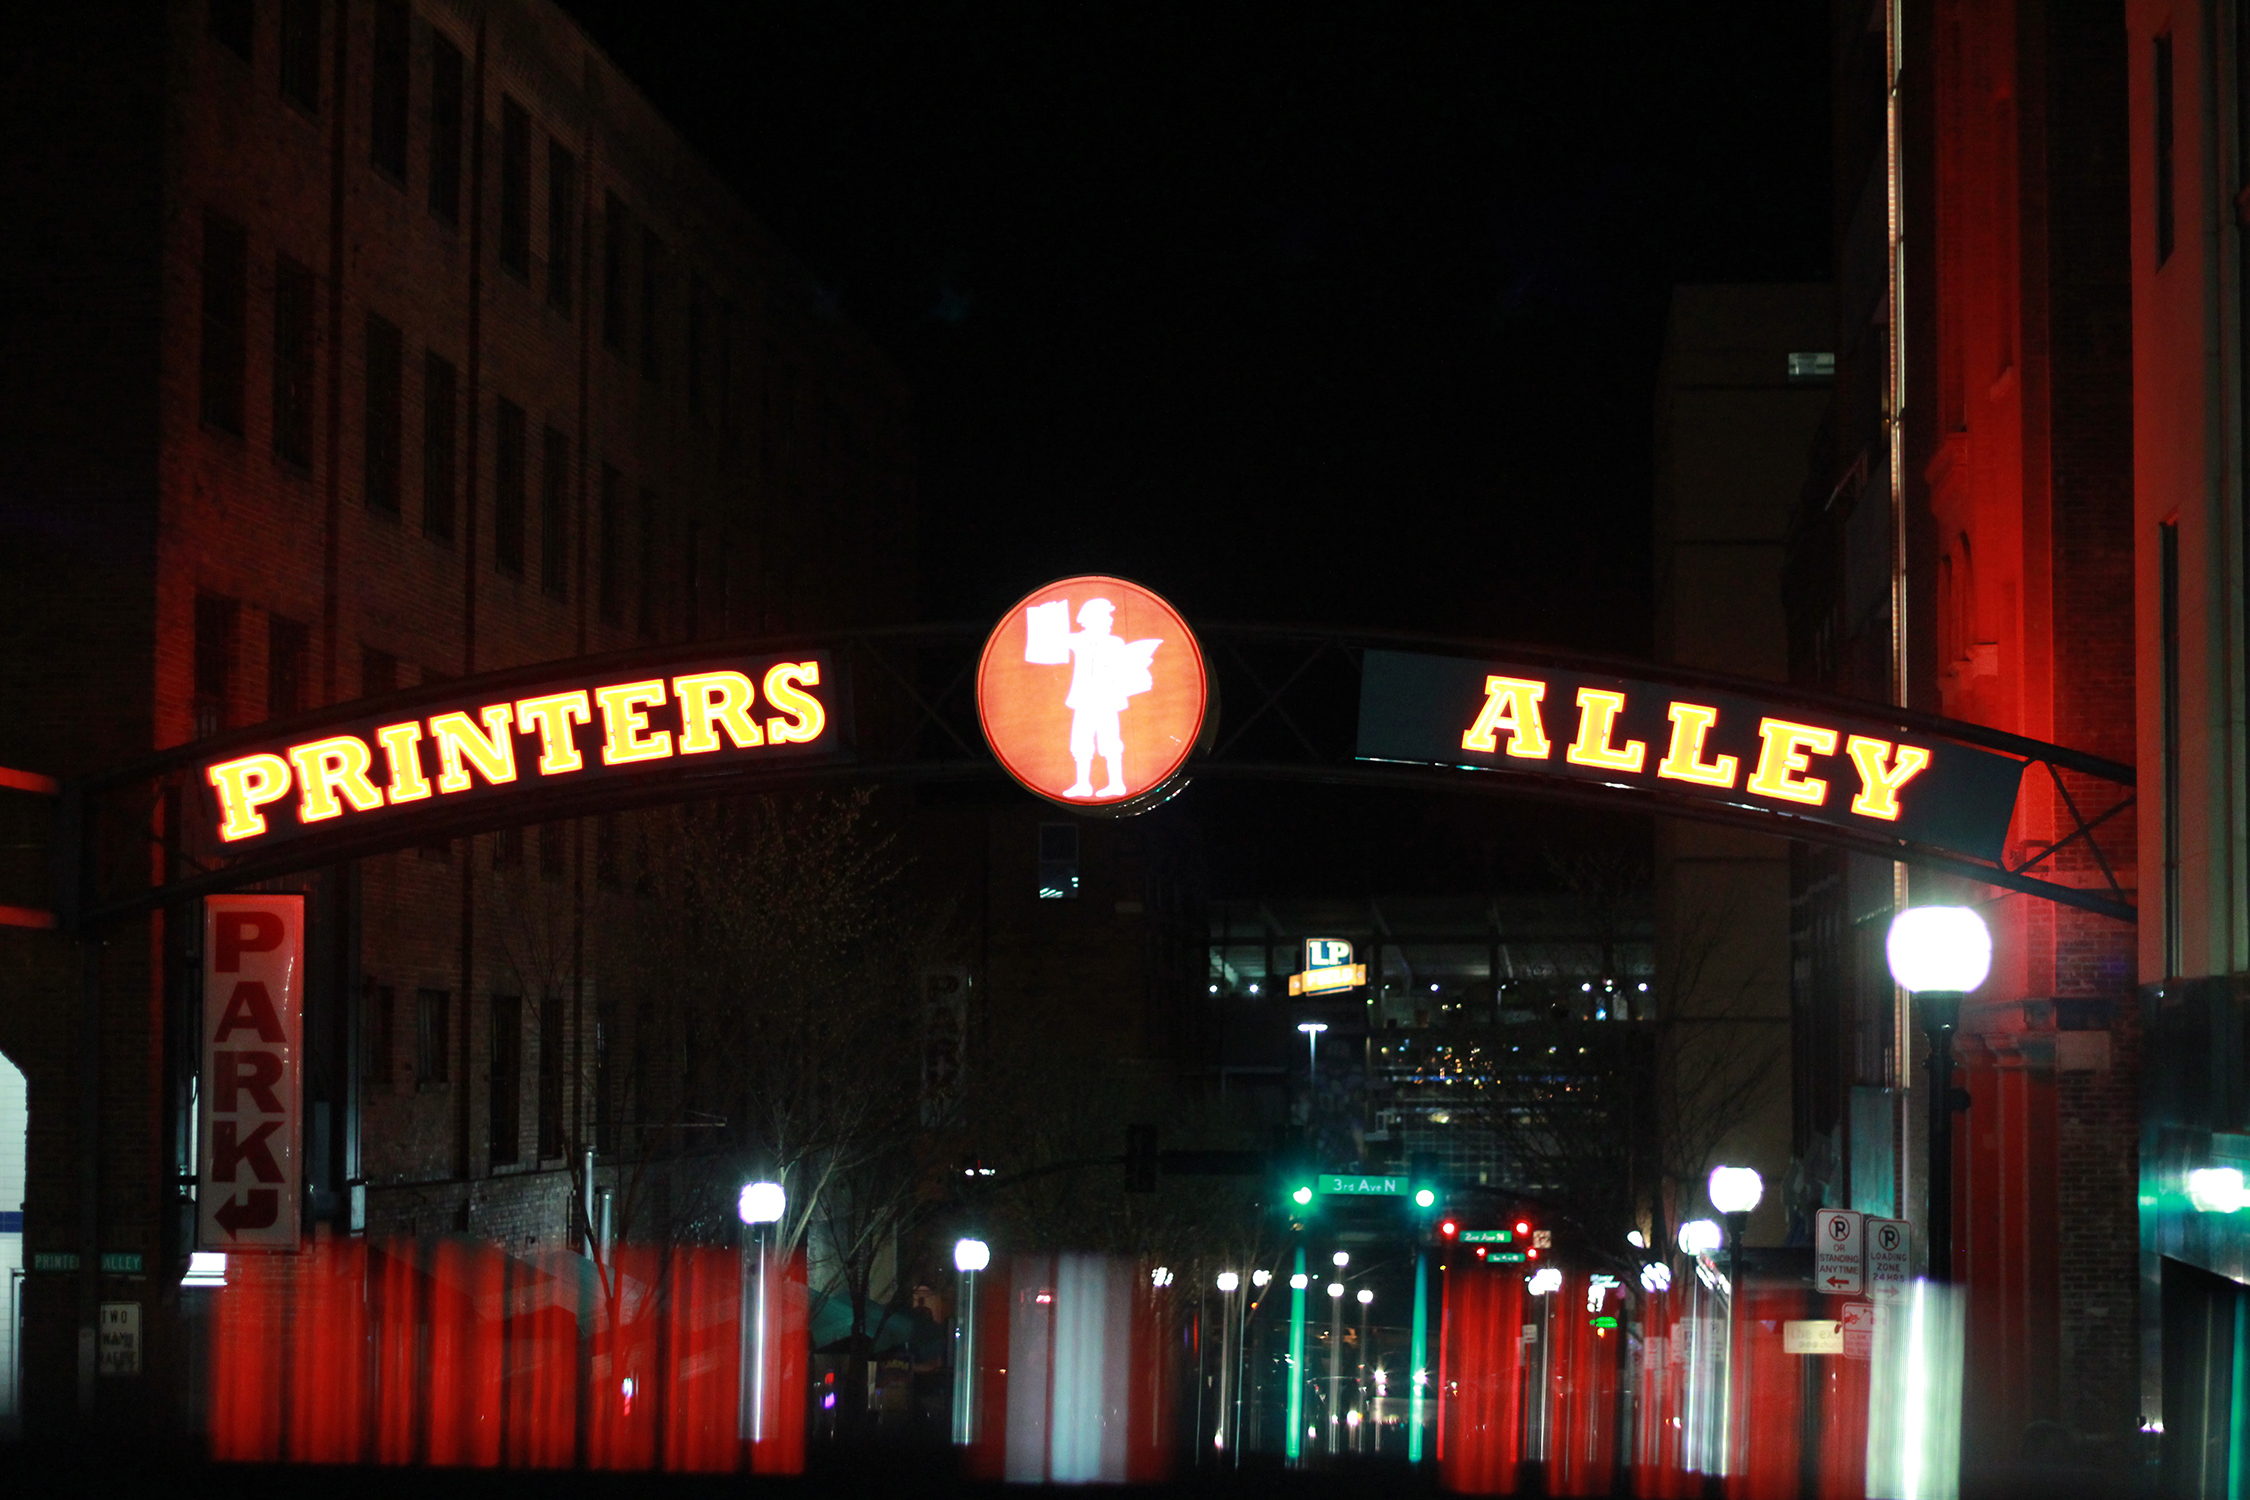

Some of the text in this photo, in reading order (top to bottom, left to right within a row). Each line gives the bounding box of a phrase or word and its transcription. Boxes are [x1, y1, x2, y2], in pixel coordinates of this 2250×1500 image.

[208, 660, 1931, 843] PRINTERS ALLEY
[1309, 941, 1350, 966] LP
[212, 911, 287, 1184] PARK
[1333, 1178, 1396, 1192] 3rd Ave N
[1833, 1244, 1846, 1253] OR
[1819, 1254, 1859, 1263] STANDING
[1870, 1252, 1907, 1262] LOADING
[1819, 1265, 1859, 1275] ANYTIME
[1876, 1262, 1901, 1272] ZONE
[1873, 1273, 1905, 1282] 24 HRS
[101, 1310, 128, 1323] TWO
